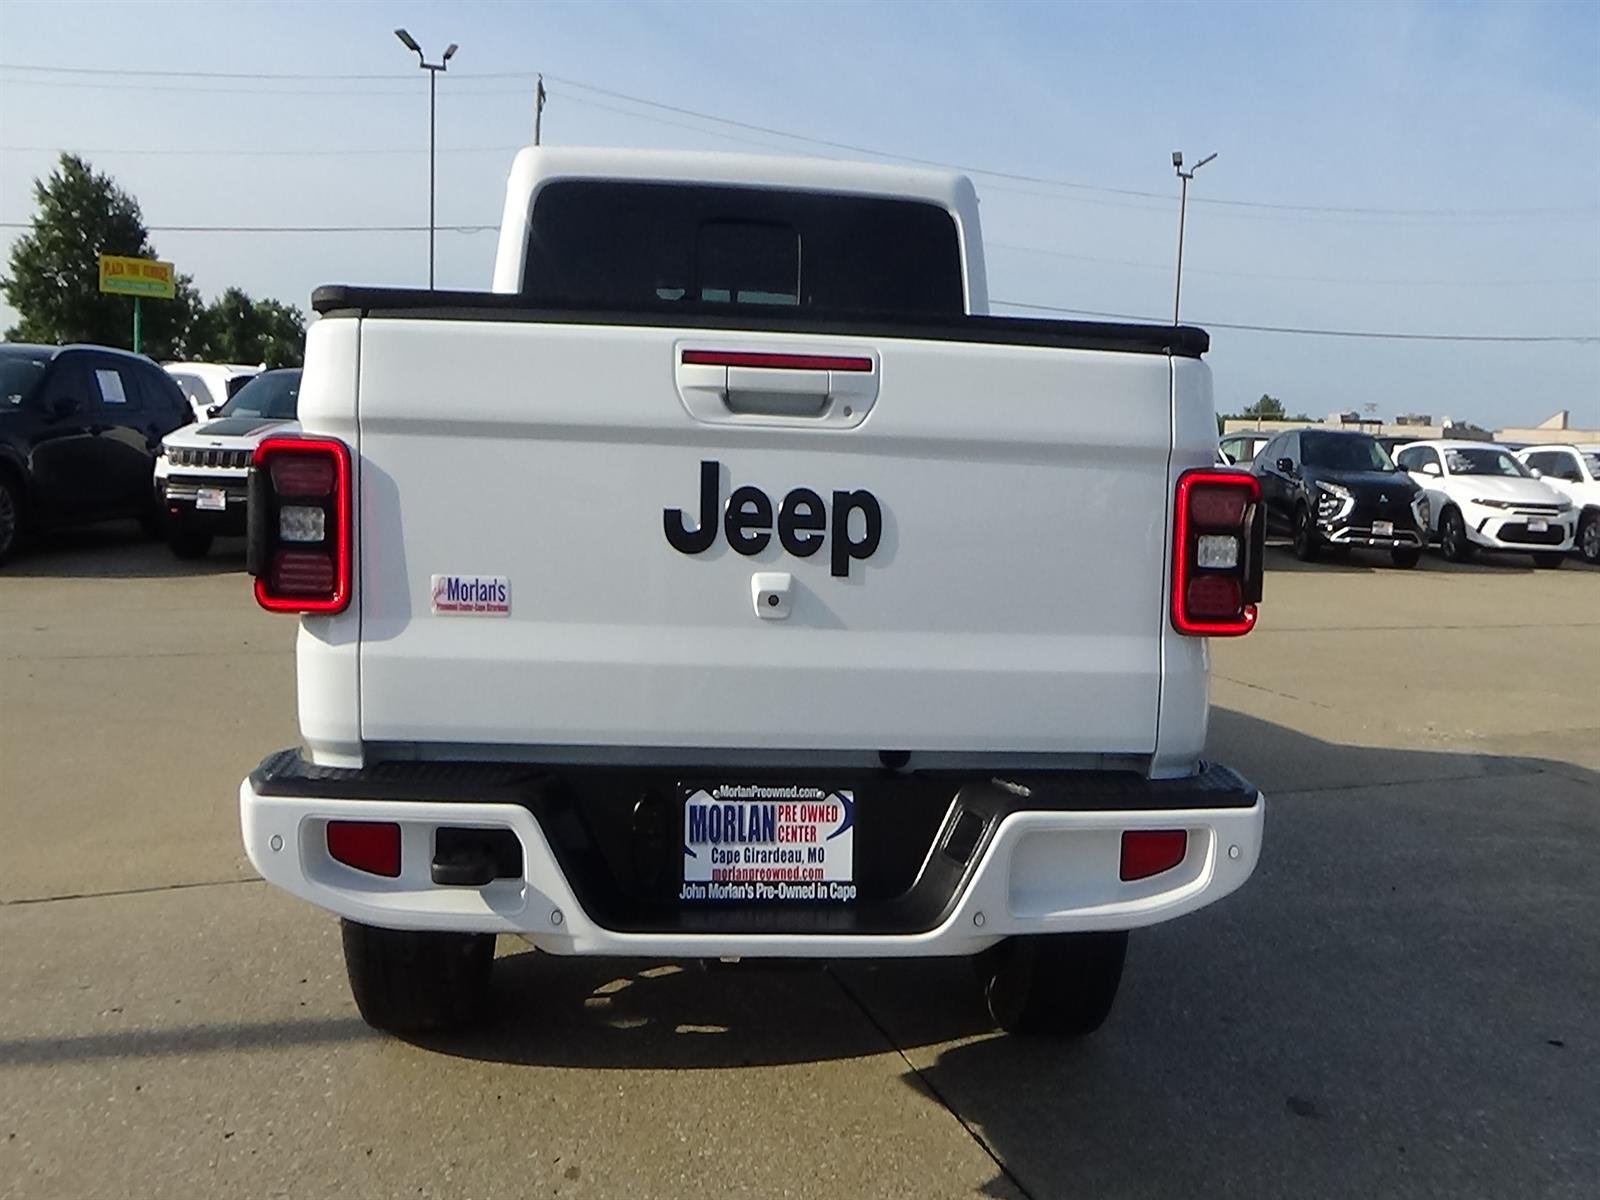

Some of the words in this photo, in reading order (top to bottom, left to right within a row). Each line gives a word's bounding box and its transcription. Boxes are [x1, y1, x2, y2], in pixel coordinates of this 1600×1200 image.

[664, 461, 882, 577] Jeep
[447, 577, 506, 602] Morlan's
[720, 785, 819, 799] MorlanPreowned.com
[778, 805, 797, 822] PRE
[800, 805, 838, 823] OWNED
[689, 804, 775, 843] MORLAN
[778, 825, 817, 843] CENTER
[711, 847, 740, 865] Cape
[743, 847, 805, 864] Girardeau,
[807, 847, 825, 863] MO
[712, 866, 824, 881] morlanpreowned.com
[679, 884, 706, 900] John
[708, 883, 754, 899] Morlan's
[756, 883, 815, 899] Pre-Owned
[817, 883, 827, 898] in
[829, 883, 857, 902] Cape
